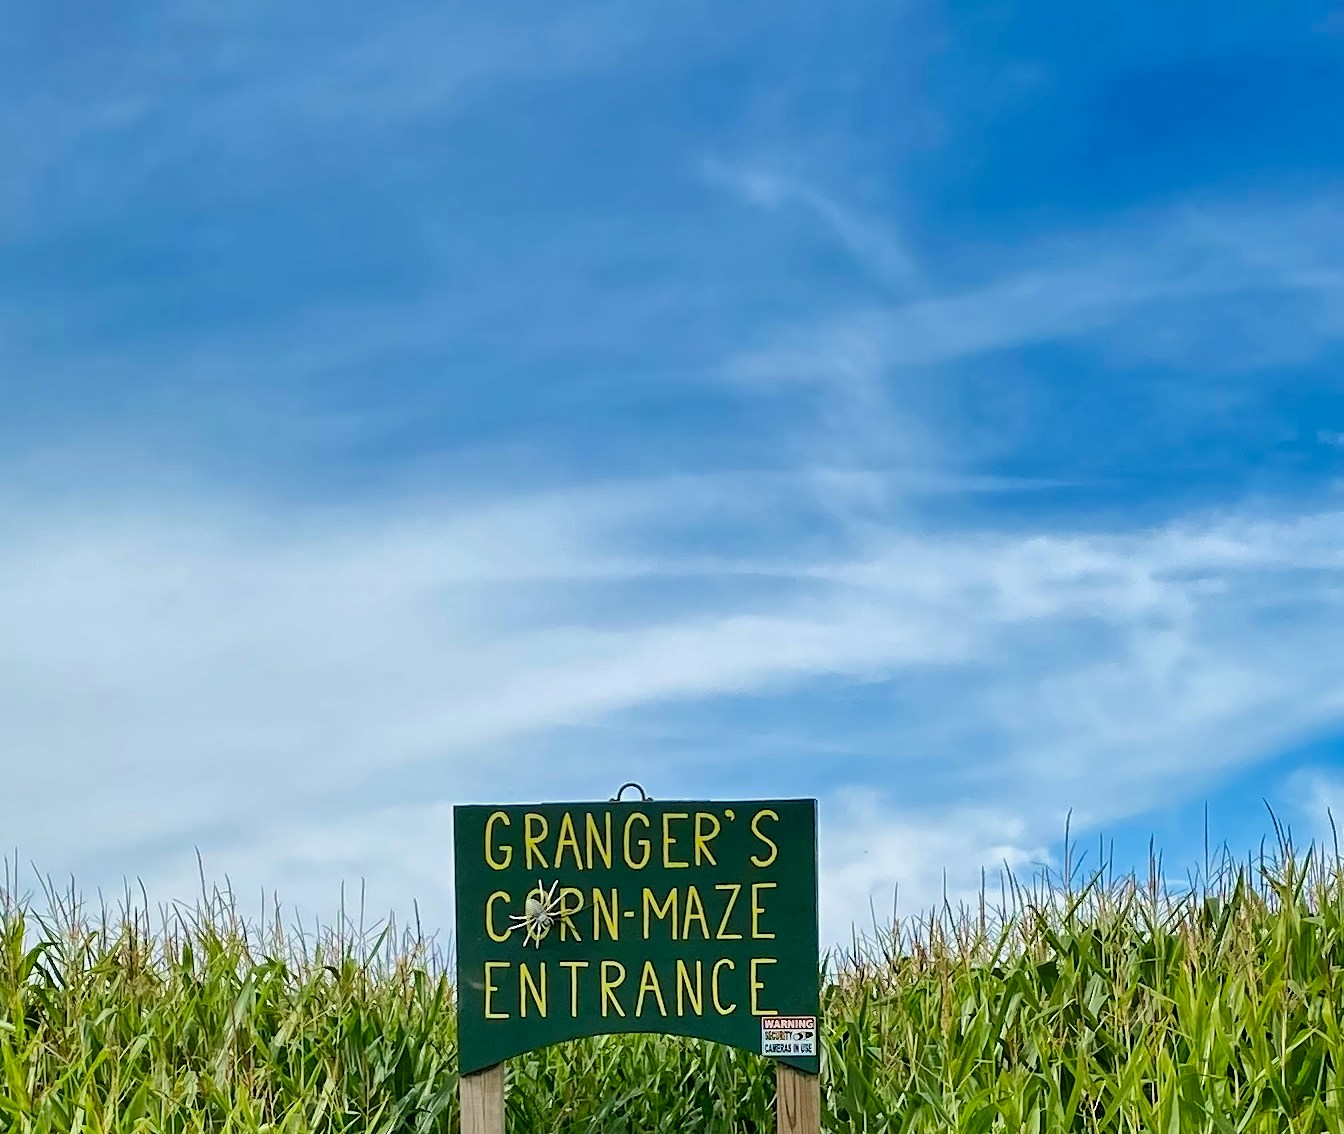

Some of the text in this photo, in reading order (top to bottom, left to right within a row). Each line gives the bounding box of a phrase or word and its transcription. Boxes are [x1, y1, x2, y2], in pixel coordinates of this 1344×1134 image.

[484, 809, 779, 870] GRANGER'S
[484, 958, 778, 1019] ENTRANCE
[764, 1019, 814, 1029] WARNING
